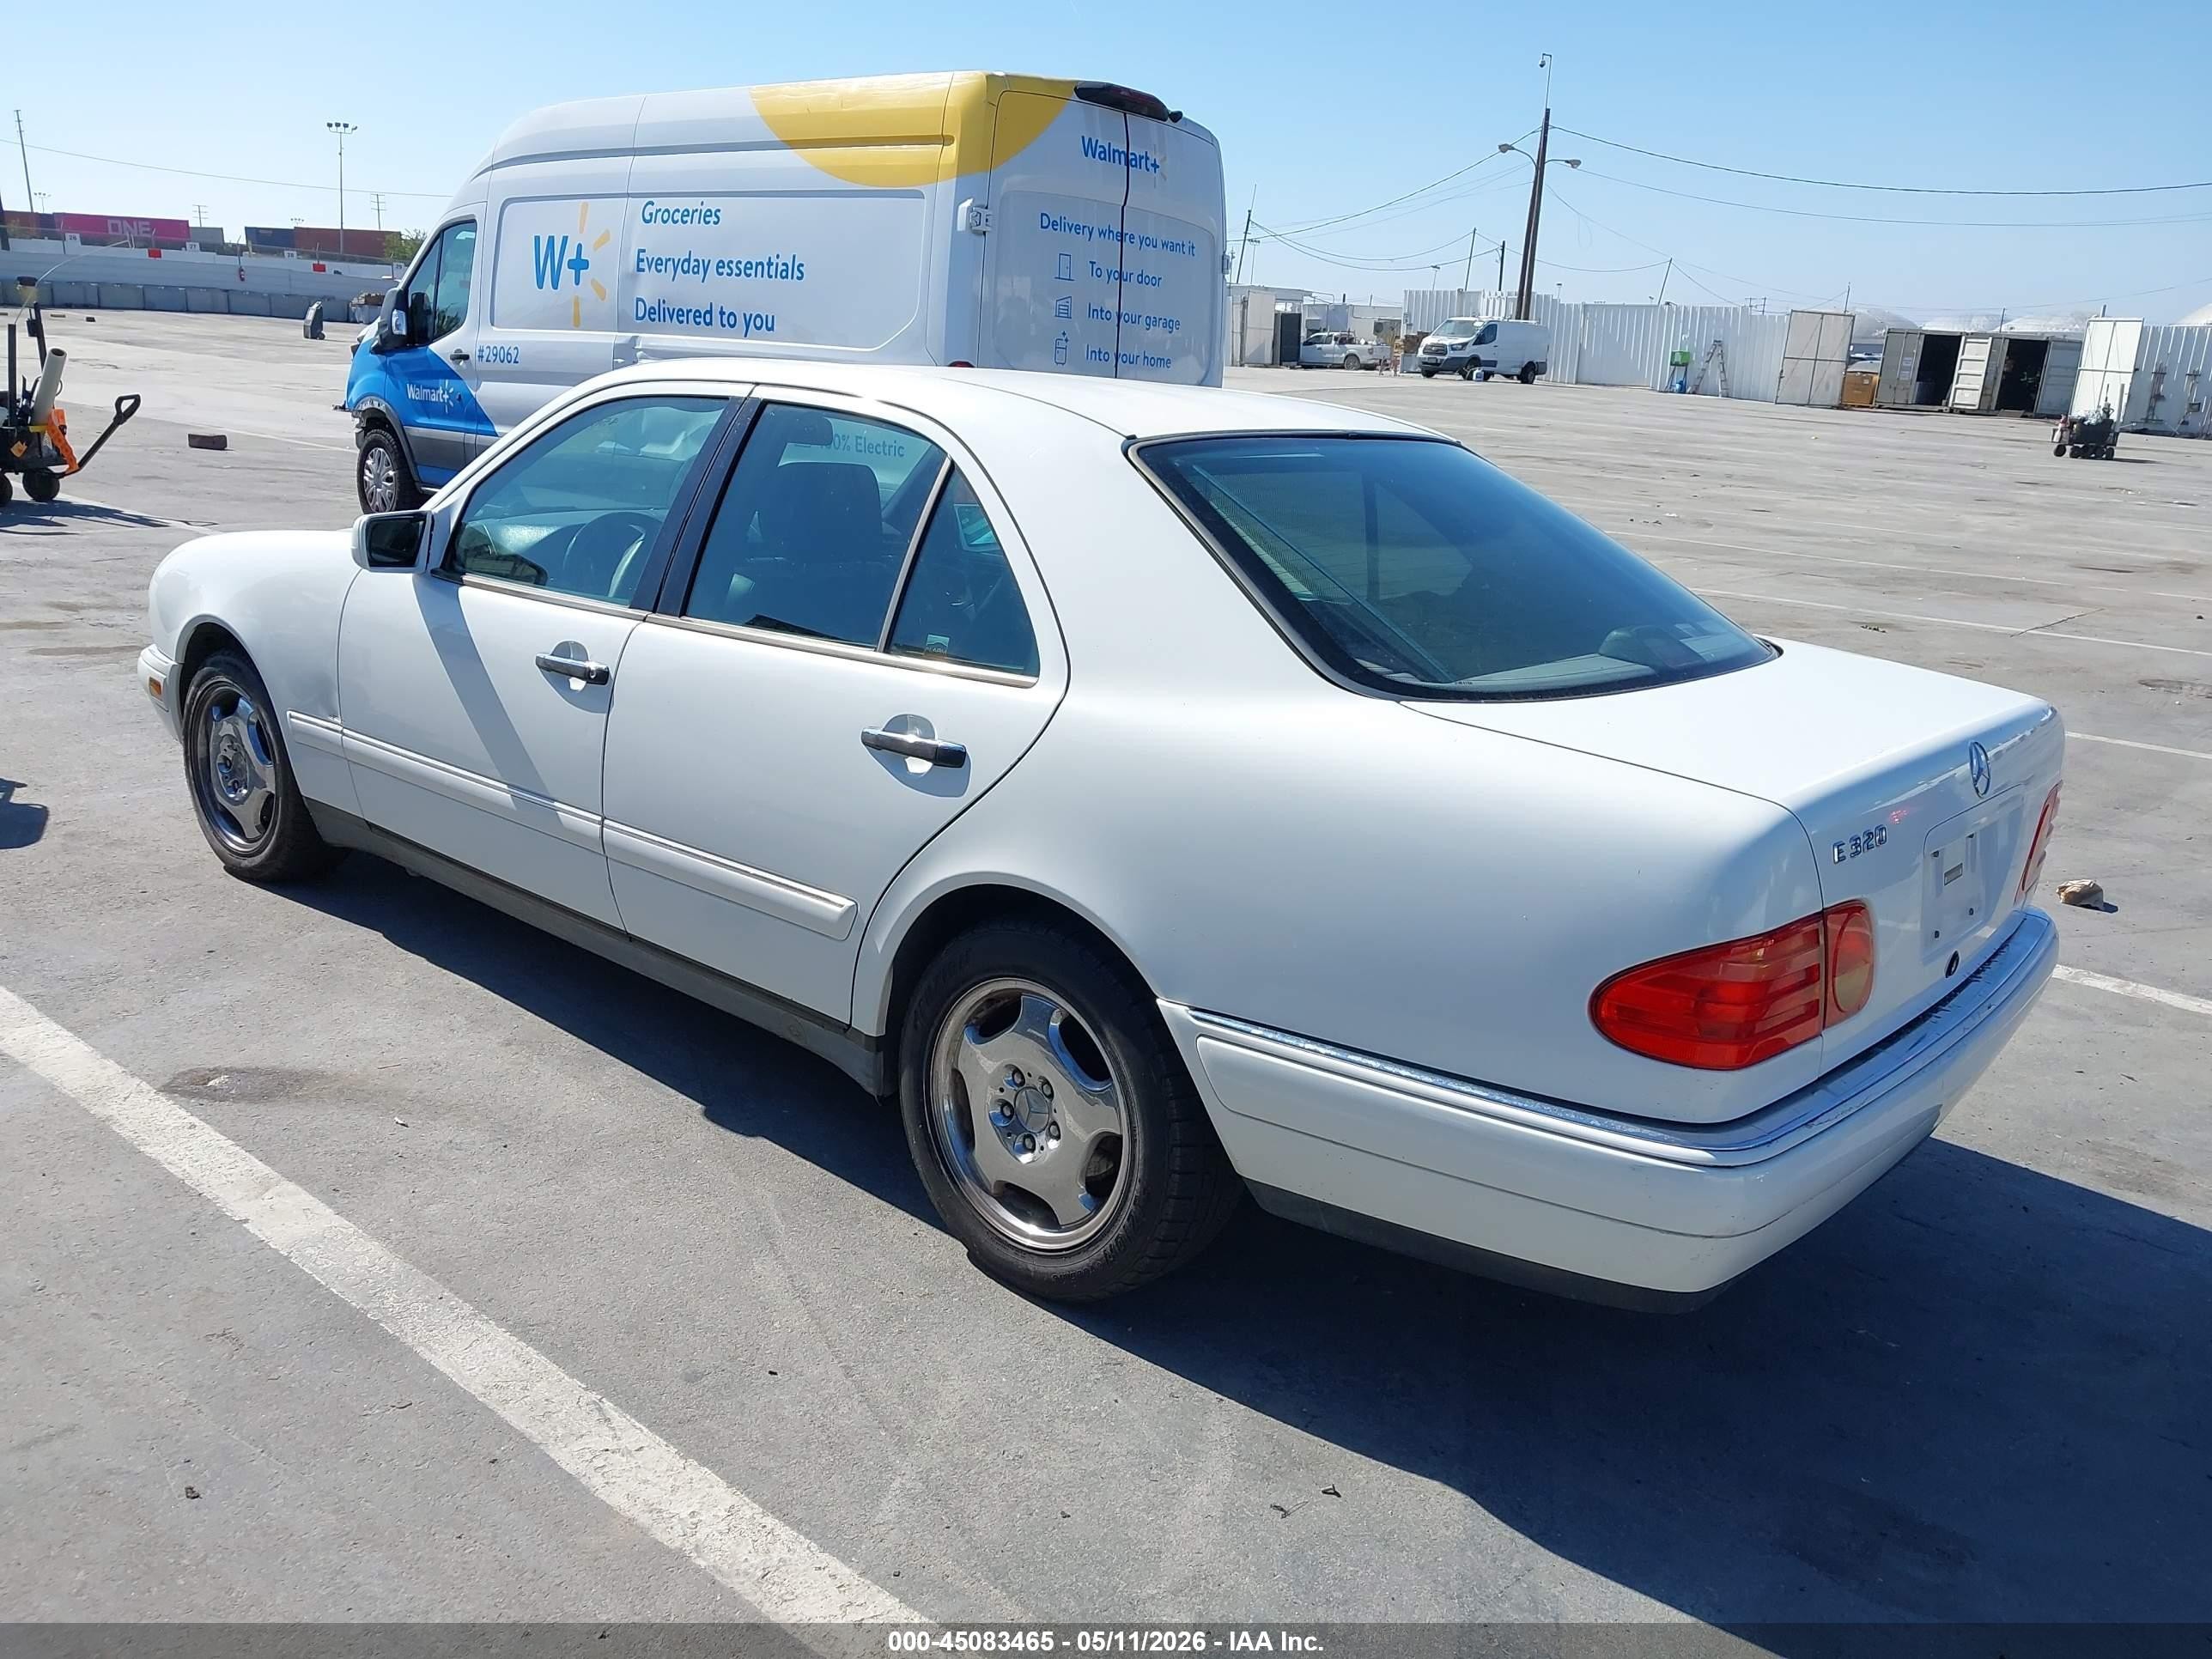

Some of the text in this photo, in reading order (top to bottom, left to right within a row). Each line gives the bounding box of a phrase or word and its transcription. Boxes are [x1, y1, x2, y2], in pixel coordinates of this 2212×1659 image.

[641, 200, 721, 226] Groceries
[107, 219, 151, 236] ONE
[1040, 212, 1195, 257] Delivery where you want it
[636, 248, 805, 283] Everyday essentials
[1089, 260, 1162, 288] To your door
[635, 297, 775, 337] Delivered to you
[1087, 302, 1112, 321] Into
[1145, 314, 1181, 334] garage
[477, 345, 520, 364] #29062
[1085, 343, 1110, 362] Into
[1143, 350, 1172, 369] home
[855, 434, 905, 458] Electric
